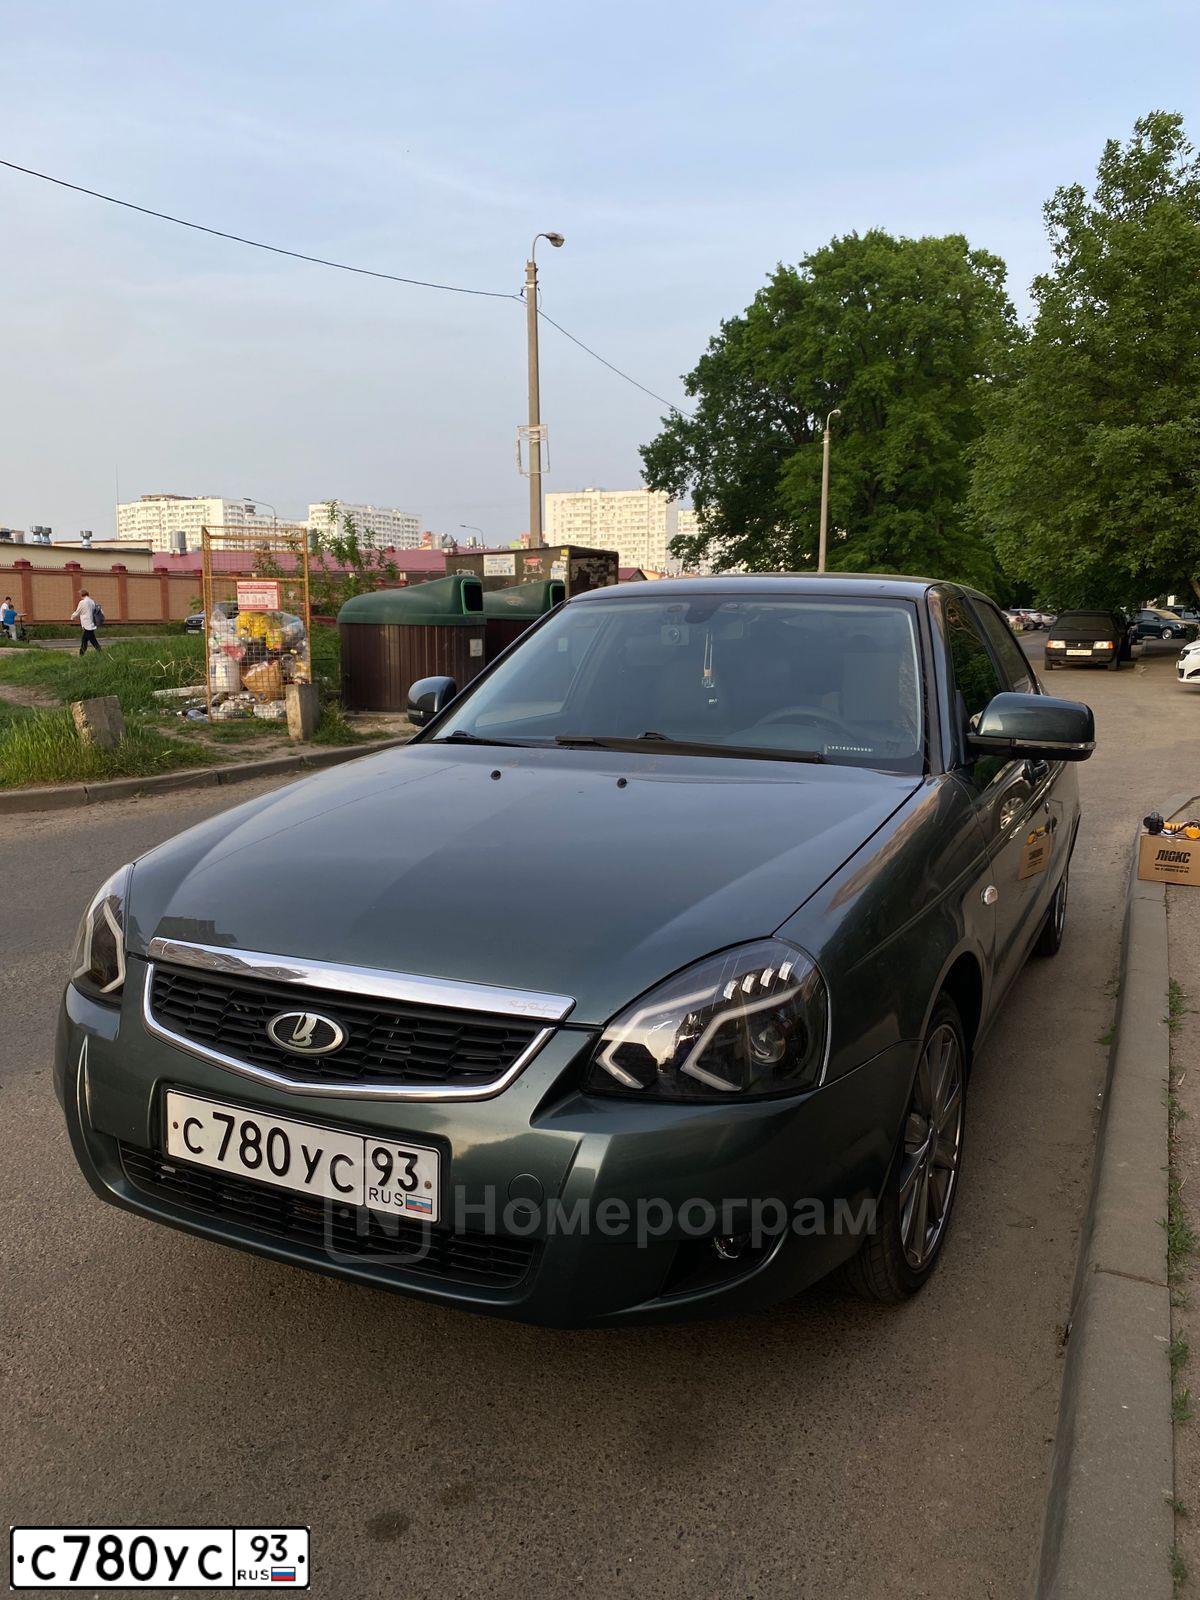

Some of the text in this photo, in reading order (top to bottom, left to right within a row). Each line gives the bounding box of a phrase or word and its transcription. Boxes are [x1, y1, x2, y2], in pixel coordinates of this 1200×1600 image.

[183, 1111, 419, 1193] С780УС 93
[368, 1186, 404, 1207] RUS
